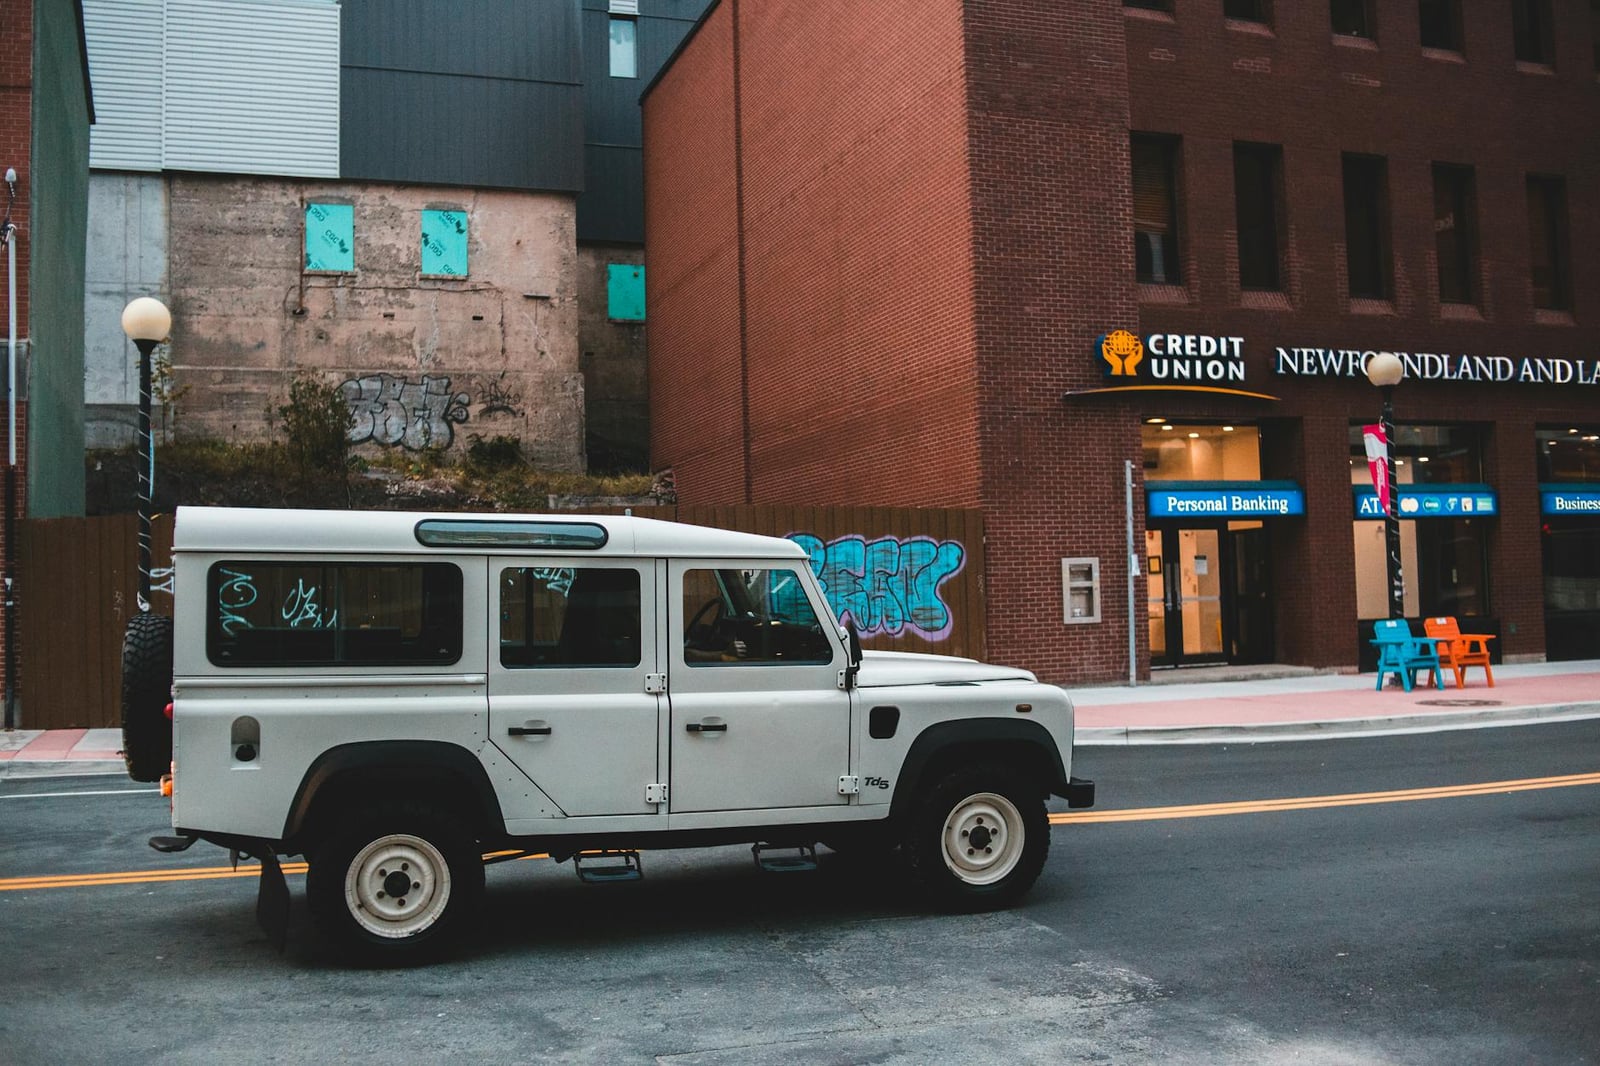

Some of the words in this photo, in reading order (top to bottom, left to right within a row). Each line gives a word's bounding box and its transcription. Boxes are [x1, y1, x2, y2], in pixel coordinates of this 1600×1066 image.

[1148, 333, 1245, 358] CREDIT
[1151, 358, 1245, 381] UNION
[1518, 357, 1574, 384] AND
[1167, 495, 1227, 512] Personal
[1231, 495, 1289, 514] Banking
[1360, 497, 1386, 514] AT
[864, 776, 890, 790] Td5
